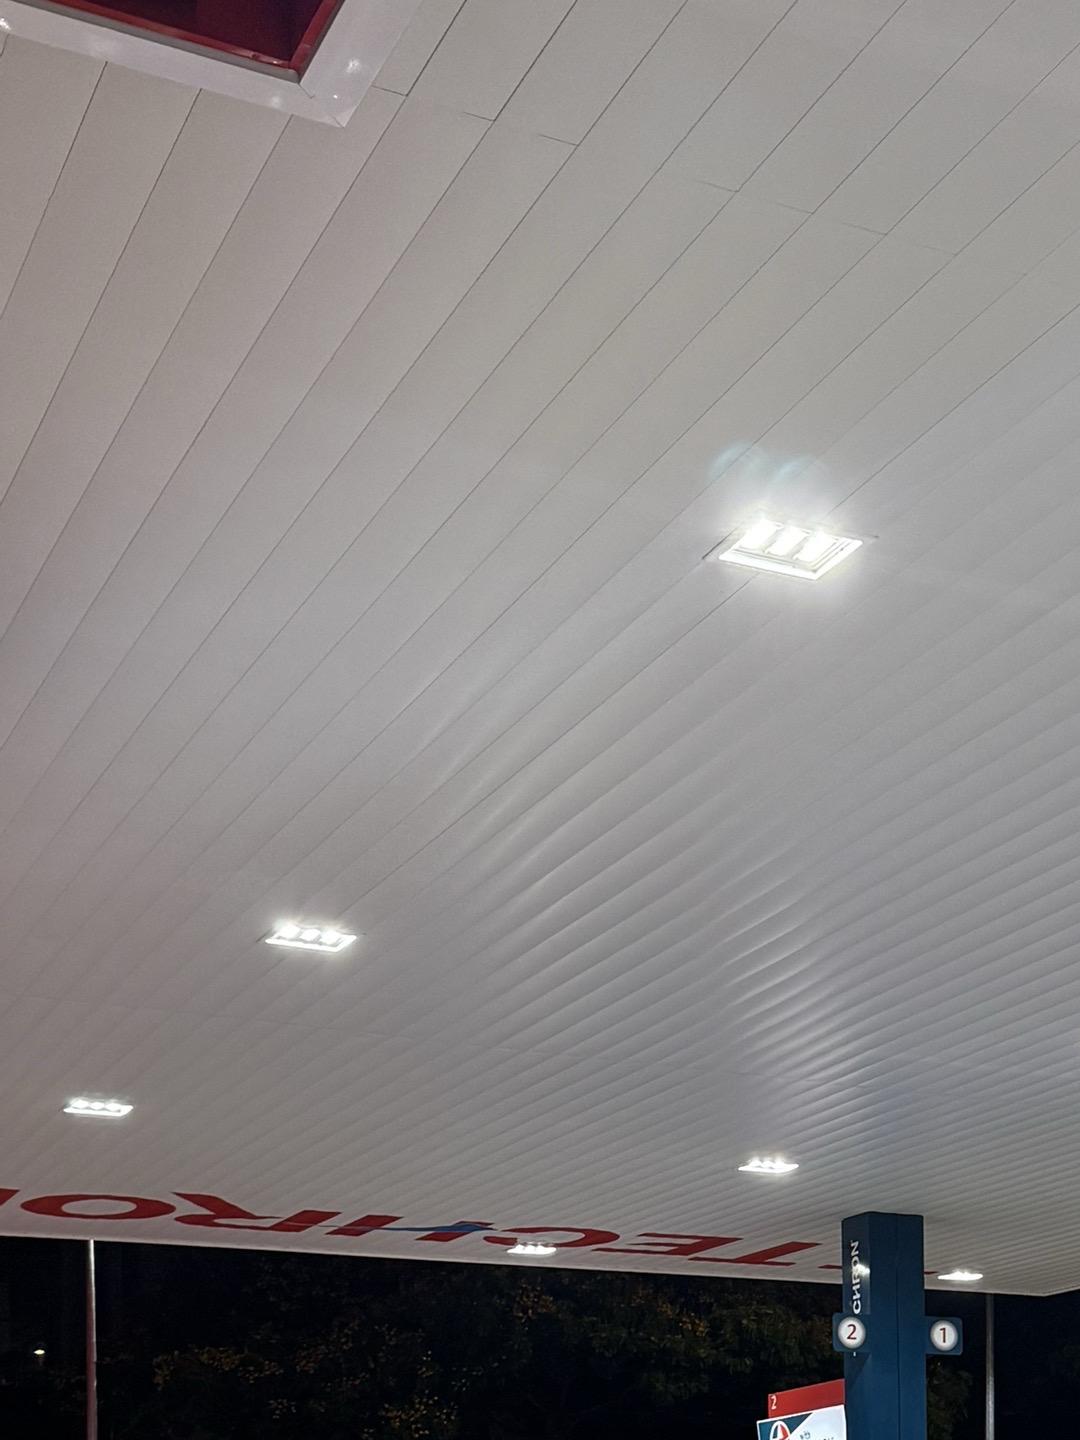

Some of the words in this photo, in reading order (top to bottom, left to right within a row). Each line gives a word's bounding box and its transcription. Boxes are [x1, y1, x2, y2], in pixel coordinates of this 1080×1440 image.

[0, 1188, 822, 1267] TECHRO
[846, 1324, 857, 1341] 2
[939, 1327, 947, 1344] 1
[770, 1394, 778, 1410] 2
